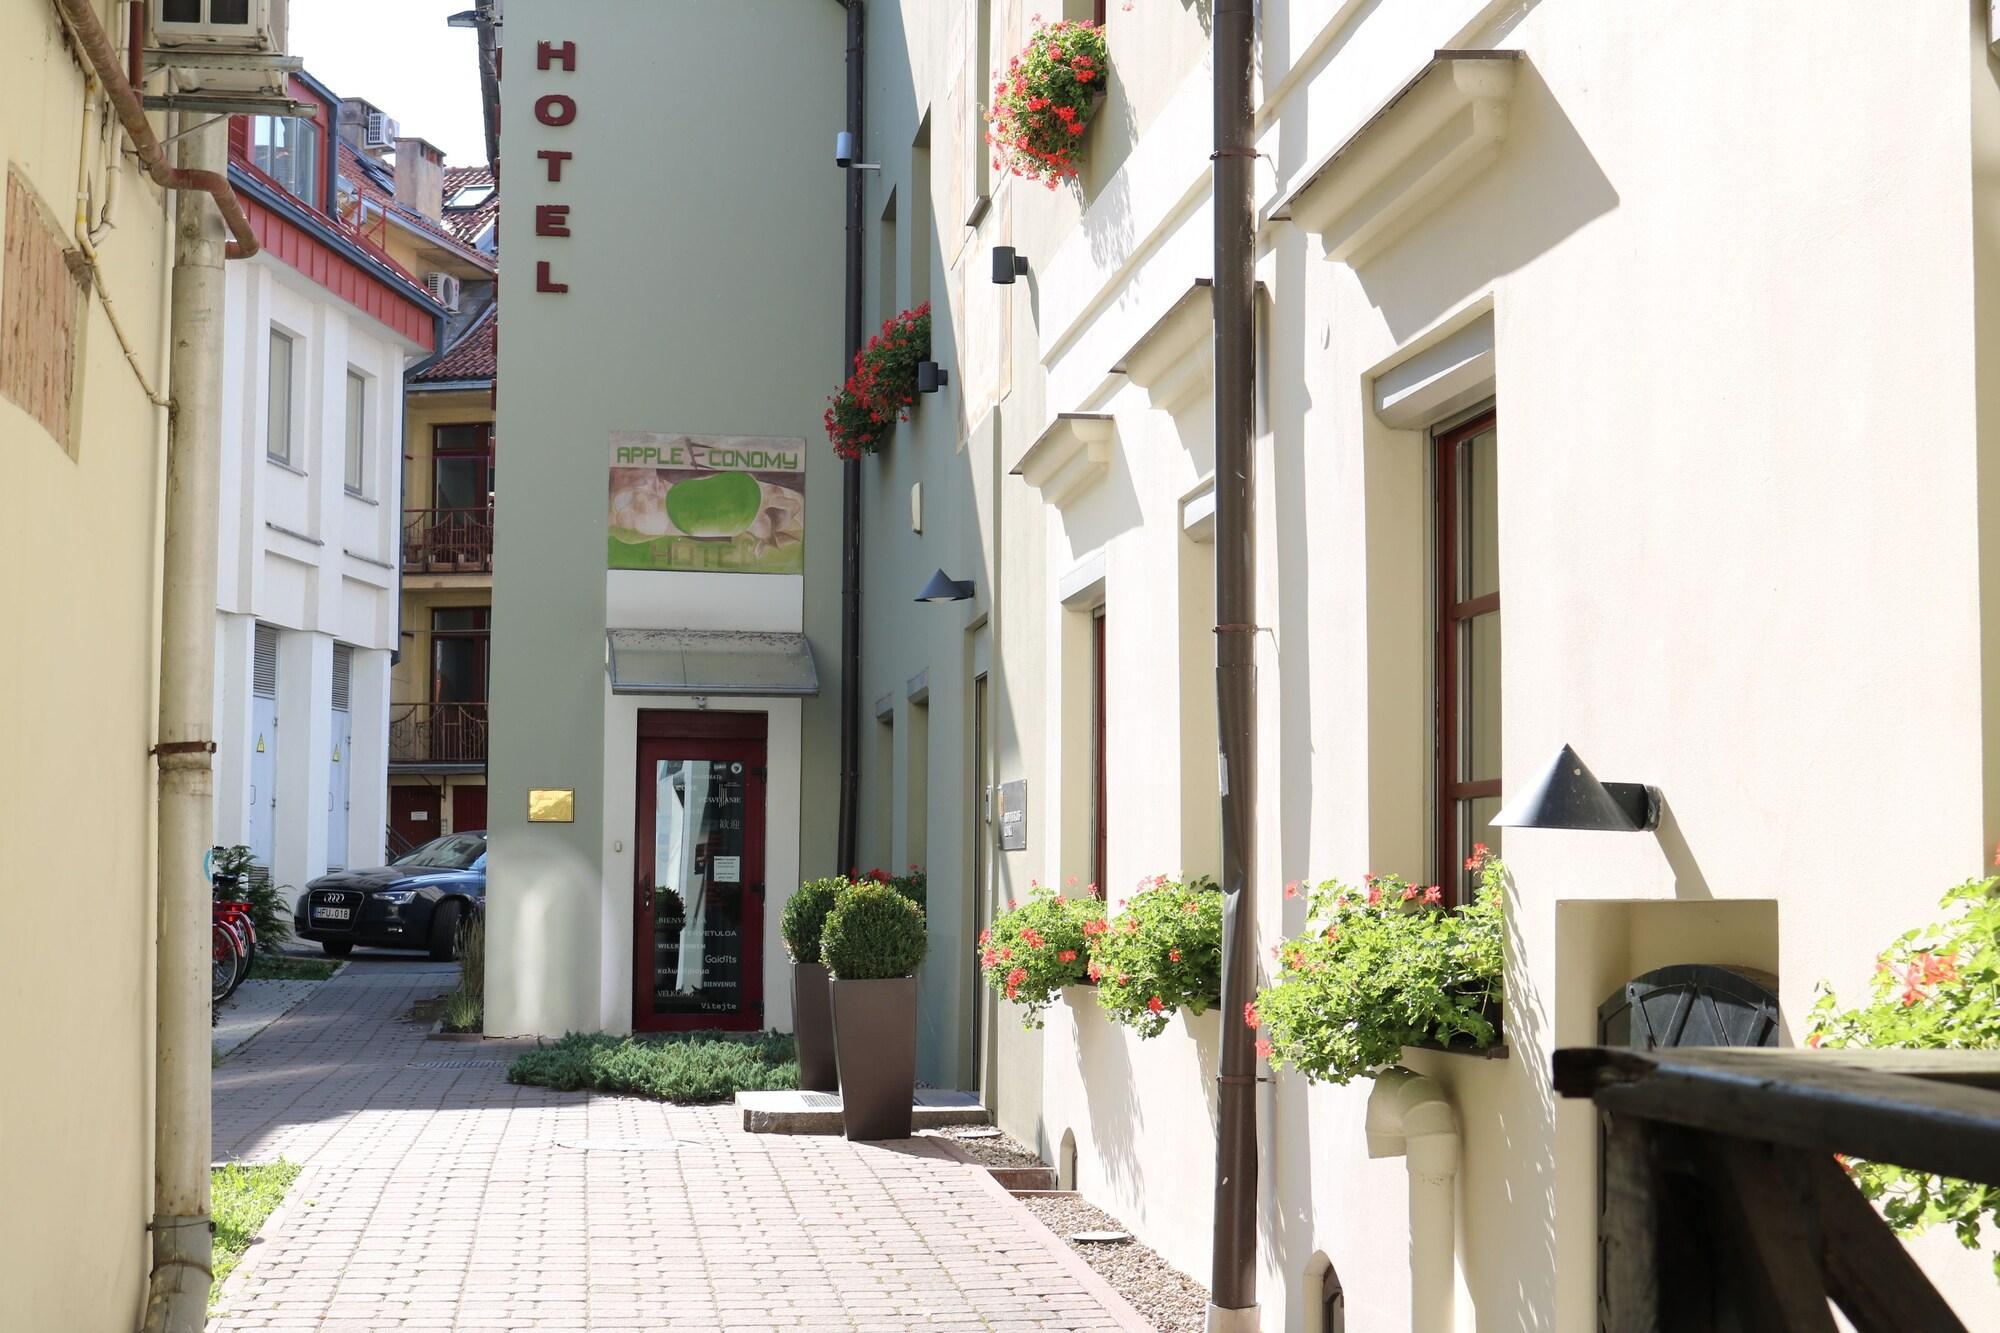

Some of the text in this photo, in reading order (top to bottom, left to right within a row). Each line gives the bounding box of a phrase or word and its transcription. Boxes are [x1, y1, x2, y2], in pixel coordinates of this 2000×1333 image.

[535, 41, 576, 293] HOTEL
[617, 437, 798, 470] APPLE ECONOMY
